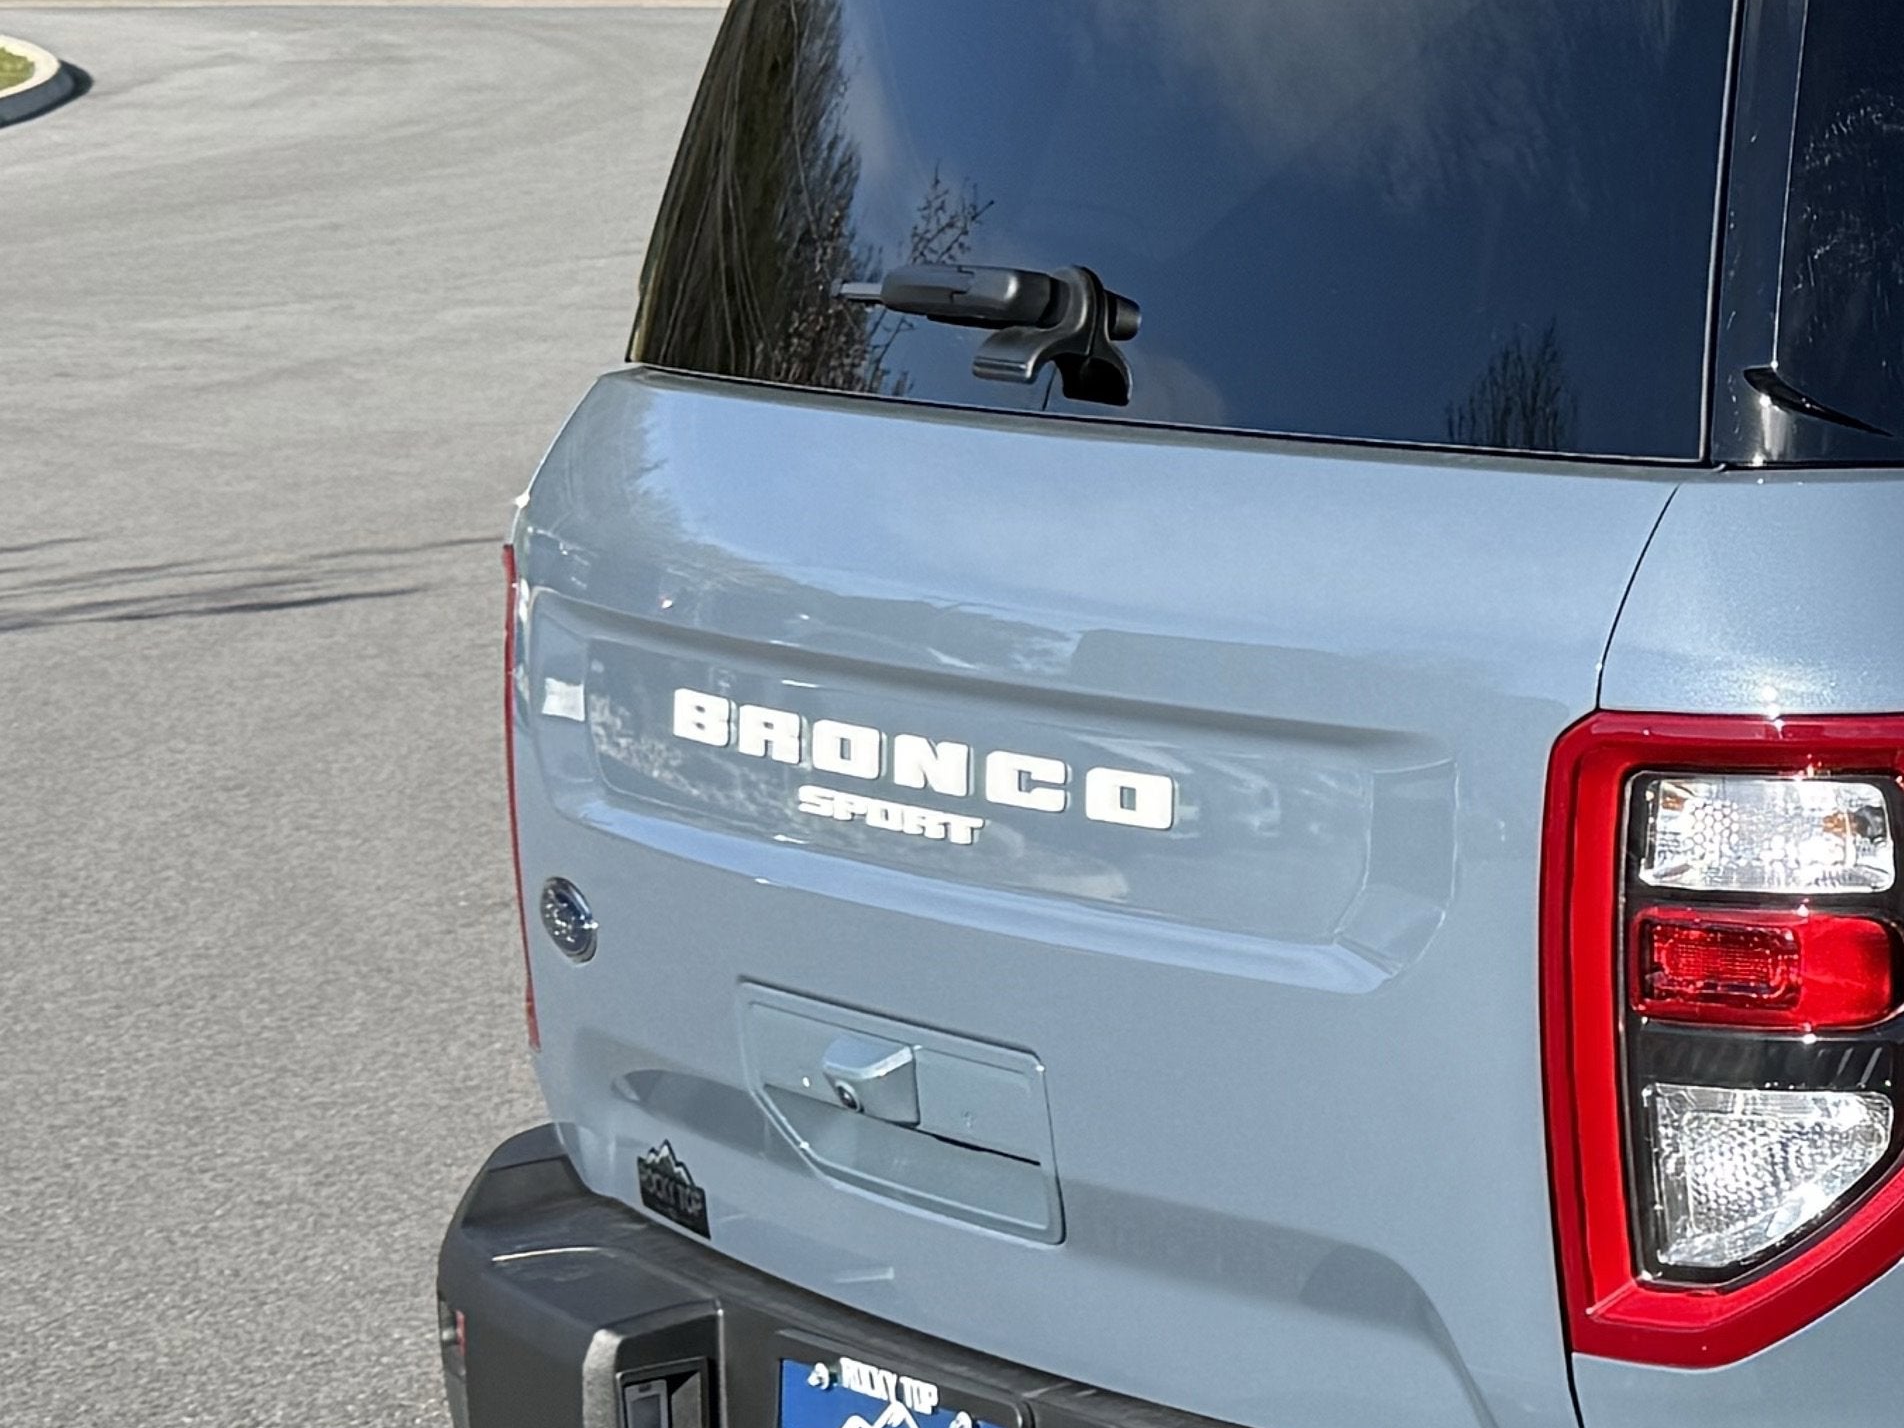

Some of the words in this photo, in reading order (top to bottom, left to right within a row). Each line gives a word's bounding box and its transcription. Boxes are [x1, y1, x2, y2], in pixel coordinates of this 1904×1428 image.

[673, 688, 1179, 831] BRONCO
[798, 784, 985, 845] SPORT
[899, 1376, 940, 1415] TOP
